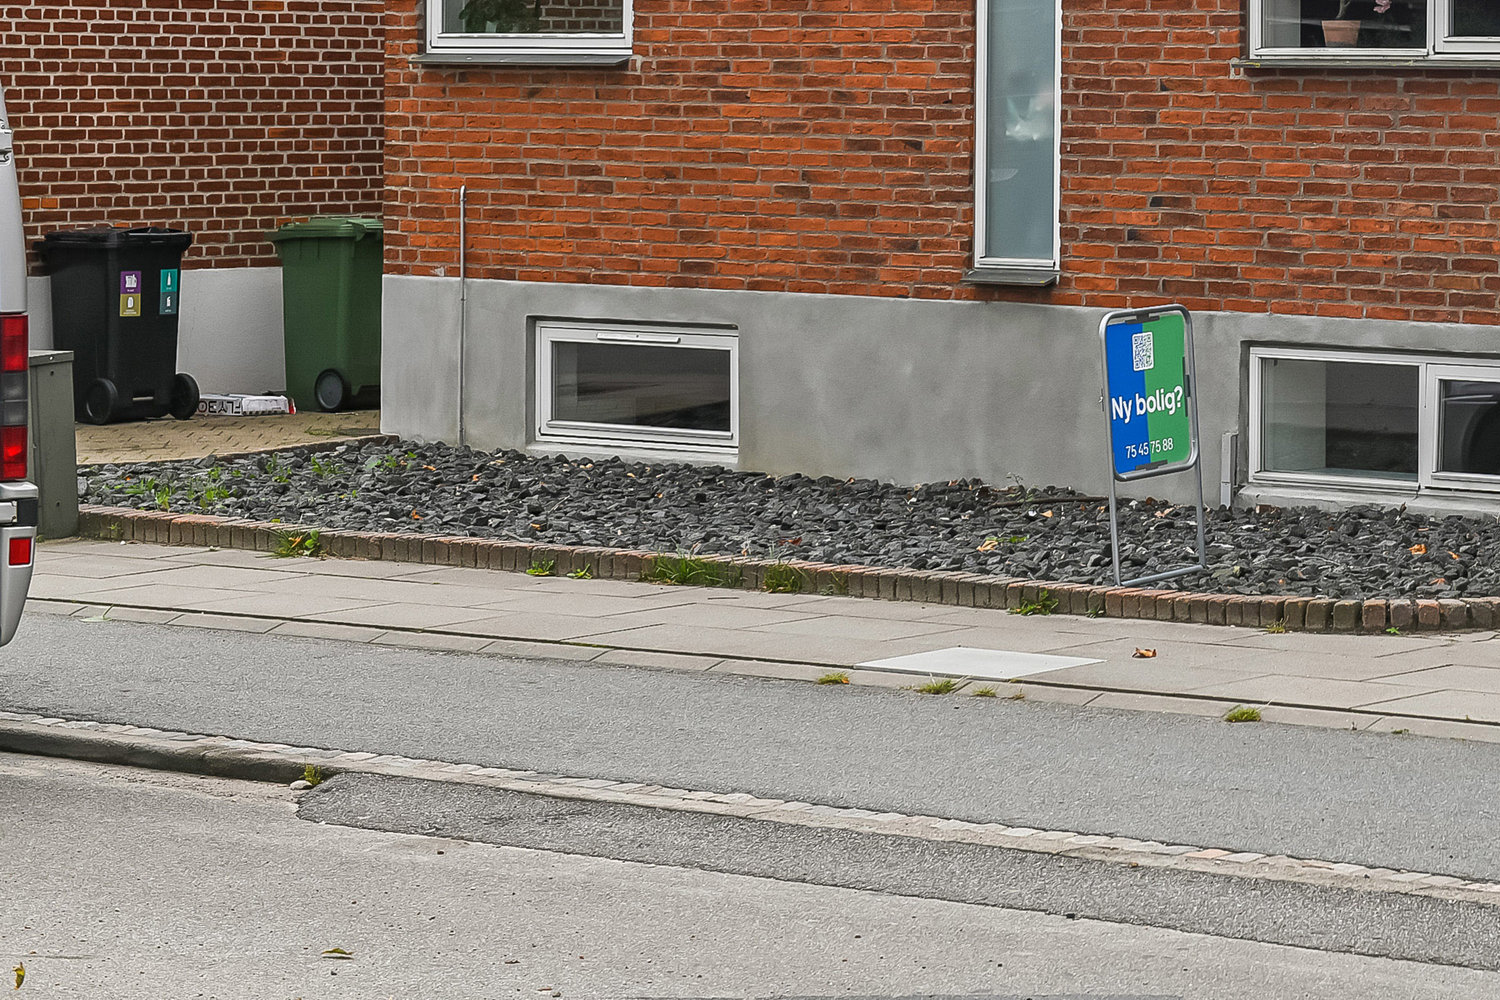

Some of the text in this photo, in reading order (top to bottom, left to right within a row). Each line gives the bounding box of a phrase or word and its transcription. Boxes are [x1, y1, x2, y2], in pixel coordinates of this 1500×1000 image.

[1111, 385, 1183, 424] Ny bolig?
[1125, 437, 1174, 459] 75 45 75 88
